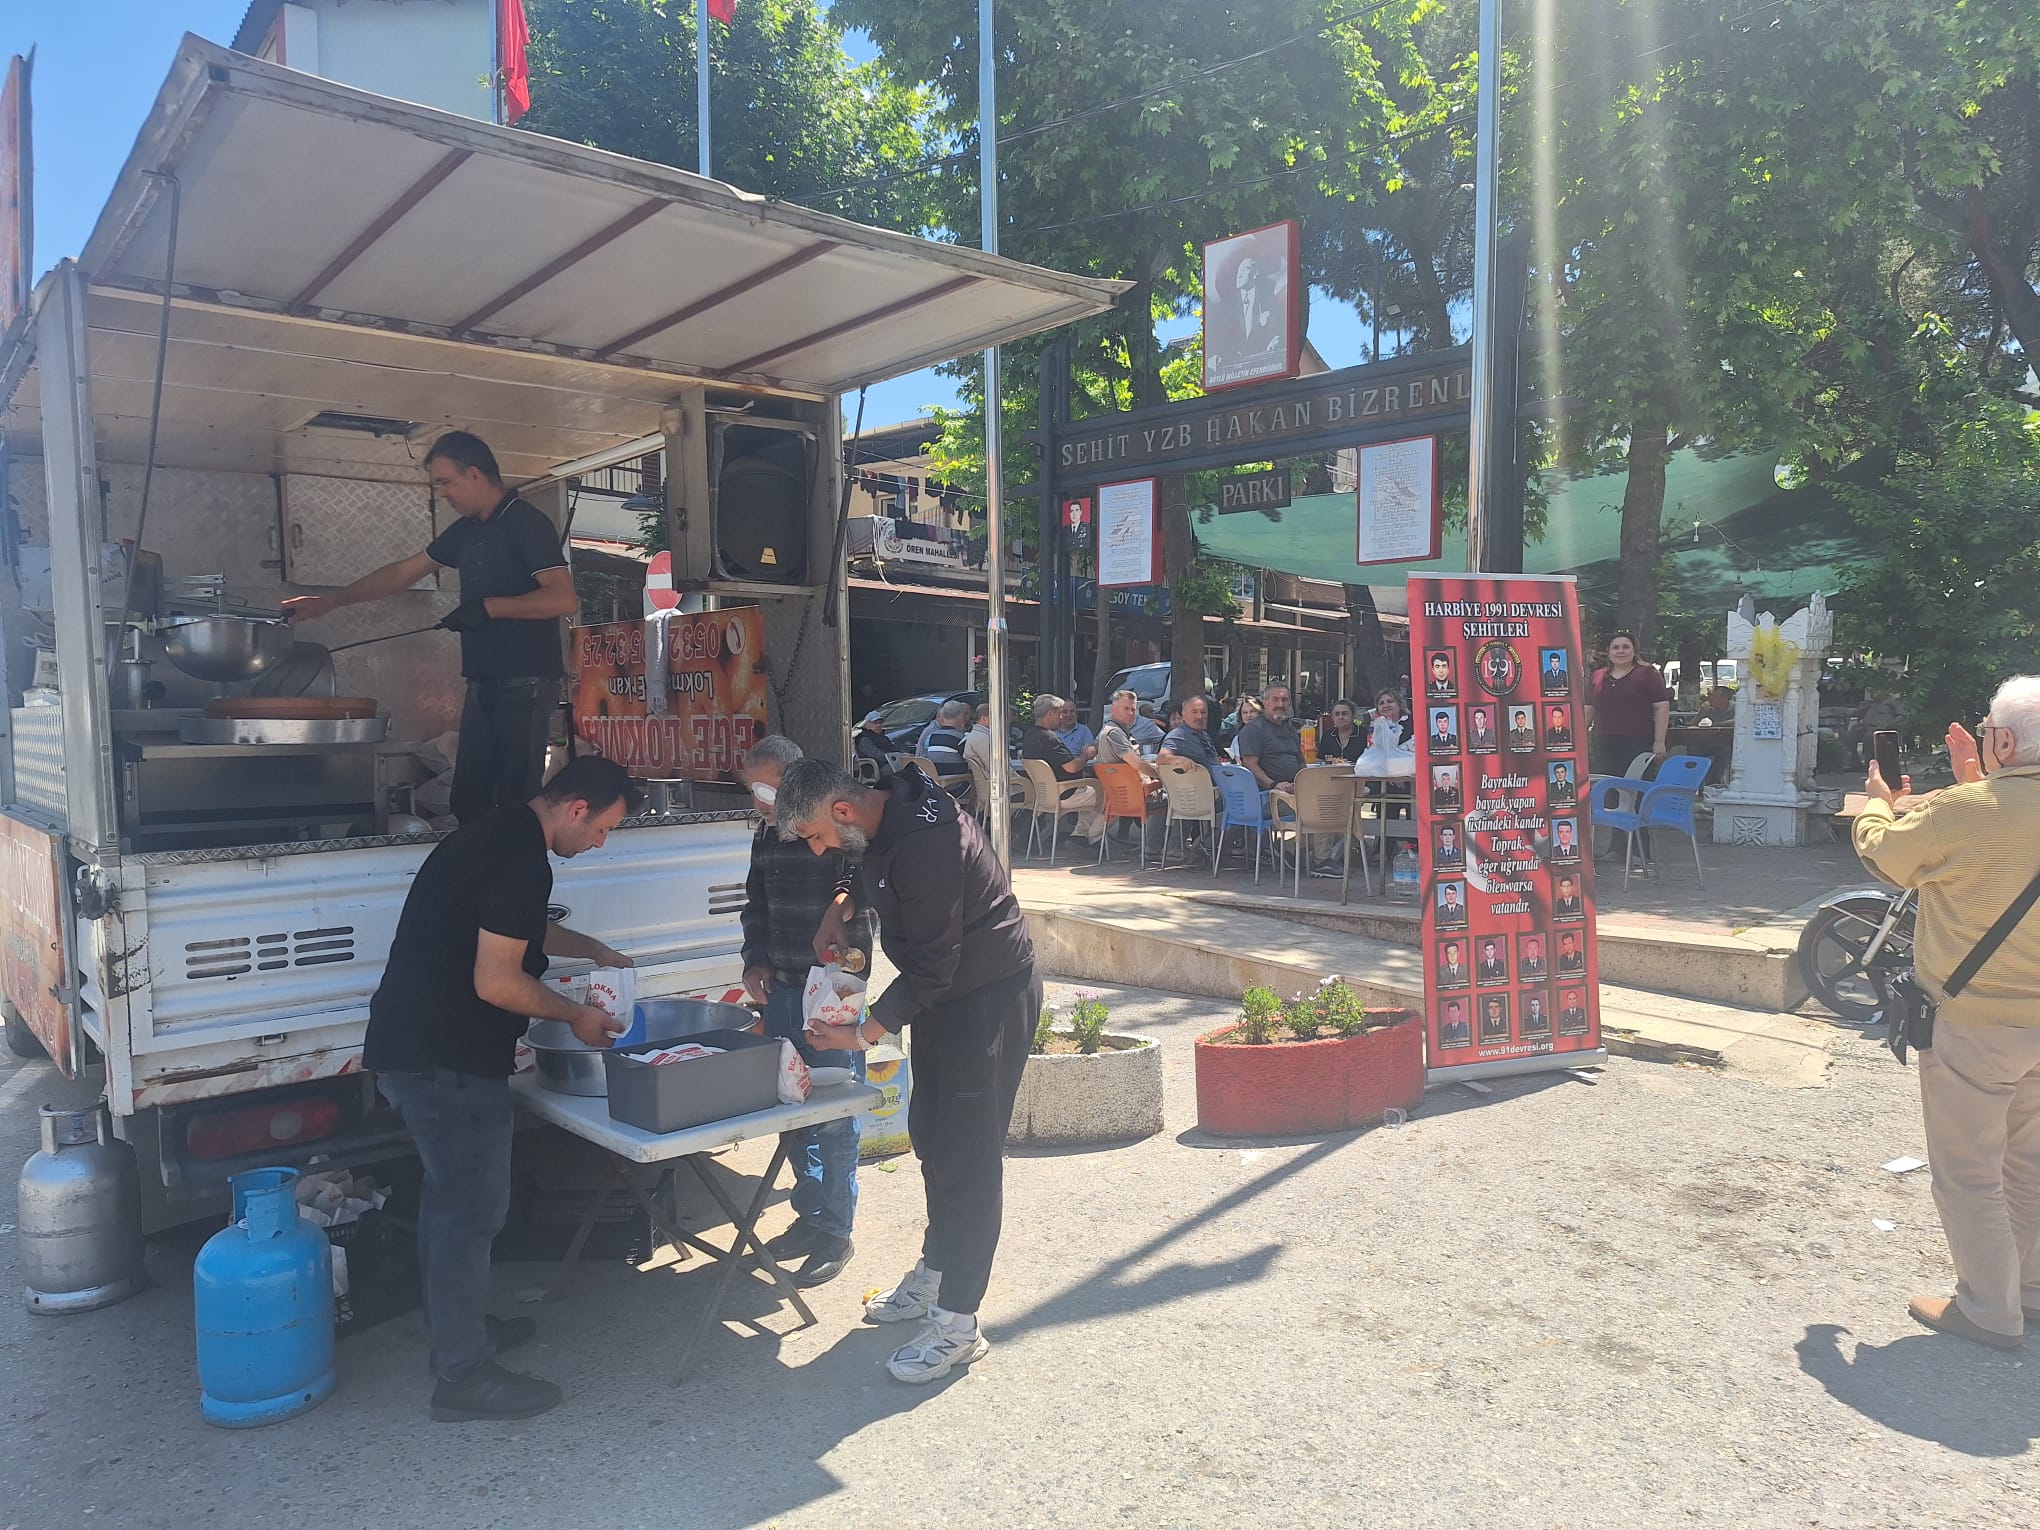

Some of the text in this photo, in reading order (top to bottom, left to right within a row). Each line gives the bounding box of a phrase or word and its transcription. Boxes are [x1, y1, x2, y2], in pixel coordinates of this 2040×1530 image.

[1143, 424, 1192, 453] YZB
[1206, 402, 1312, 444] HAKAN
[1222, 476, 1284, 508] PARKI
[1424, 599, 1563, 618] HARBİYE 1991 DEVRESİ
[1463, 620, 1529, 639] ŞEHİTLERİ
[605, 629, 627, 666] 32
[669, 621, 721, 660] 0532
[583, 635, 602, 668] 25
[1483, 658, 1513, 678] 1991
[672, 671, 714, 700] Lokm
[693, 714, 755, 772] EGE
[1481, 773, 1528, 792] Bayrakları
[1507, 797, 1536, 813] yapan
[1468, 813, 1545, 832] üstündeki kandır.
[1491, 835, 1525, 855] Toprak,
[1478, 855, 1539, 878] eğer uğrunda
[1509, 880, 1533, 892] varsa
[1490, 897, 1530, 915] vatandır.
[589, 983, 617, 1001] LOKMA
[1478, 1042, 1554, 1057] www.91devresi.org
